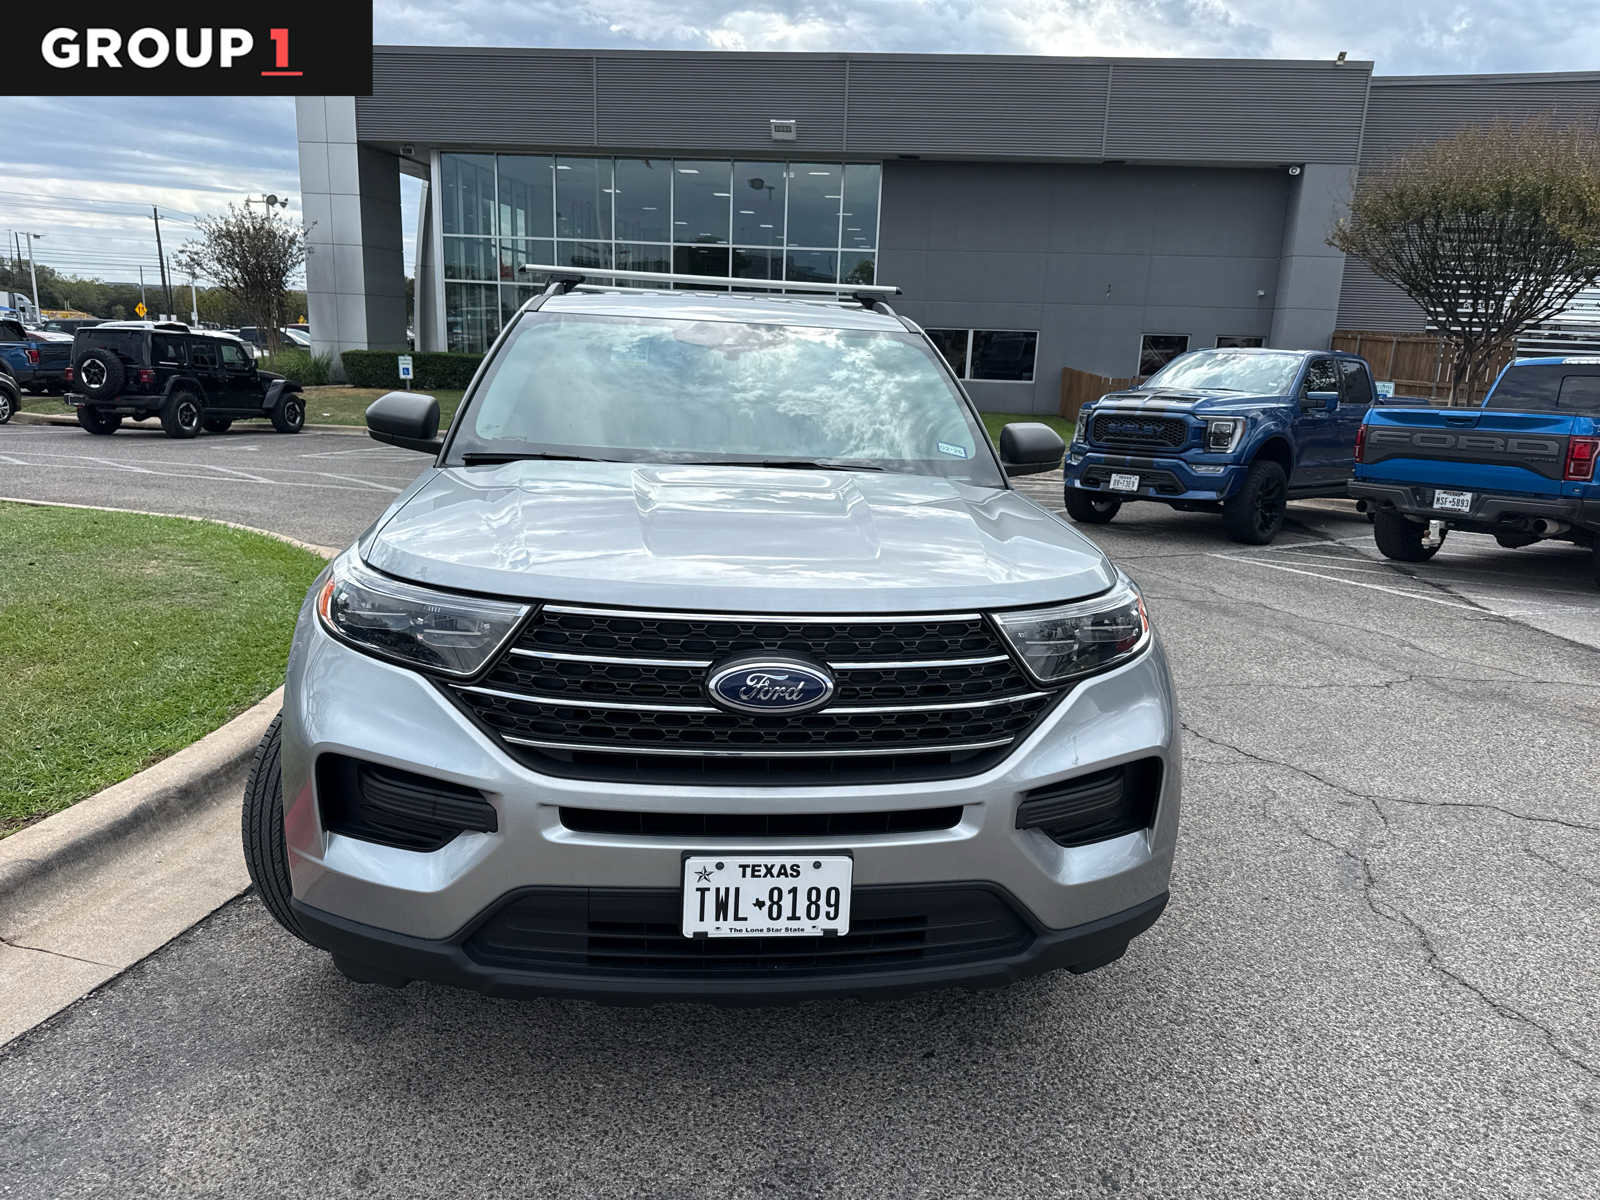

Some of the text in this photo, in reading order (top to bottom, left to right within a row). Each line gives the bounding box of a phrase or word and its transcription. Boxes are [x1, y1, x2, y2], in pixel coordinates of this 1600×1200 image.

[1368, 430, 1560, 456] FORD
[739, 672, 806, 701] Ford
[738, 863, 801, 879] TEXAS
[784, 926, 806, 934] State
